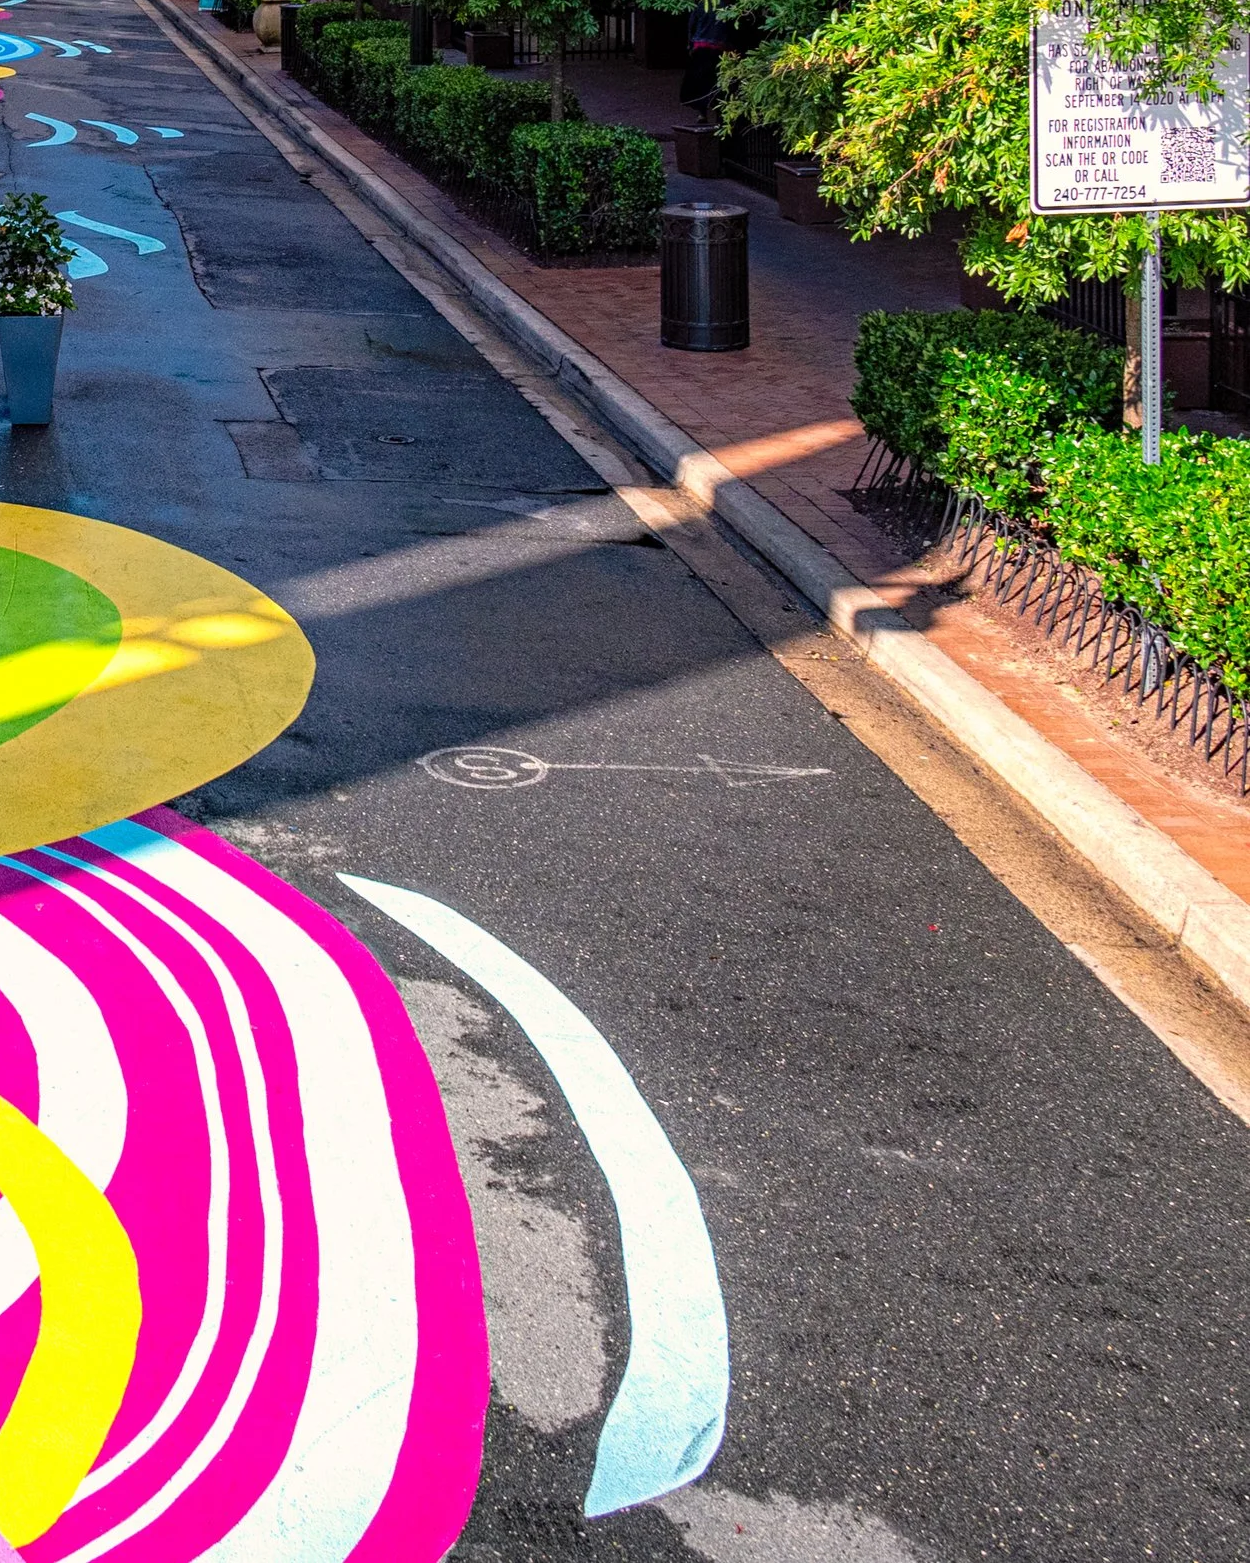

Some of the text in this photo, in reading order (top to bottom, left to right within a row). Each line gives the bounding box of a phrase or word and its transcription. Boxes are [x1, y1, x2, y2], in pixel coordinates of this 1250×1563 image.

[1048, 43, 1068, 58] HAS
[1069, 60, 1089, 74] FOR
[1095, 56, 1163, 72] ABANDONME
[1075, 76, 1104, 91] RIGHT
[1109, 76, 1123, 90] OF
[1127, 75, 1151, 90] WA
[1065, 93, 1125, 109] SEPTEMBER
[1146, 91, 1174, 106] 2020
[1048, 117, 1146, 133] FOR REGISTRATION
[1063, 134, 1131, 149] INFORMATION
[1045, 150, 1149, 167] SCAN THE QR CODE
[1075, 168, 1119, 183] OR CALL
[1054, 185, 1146, 202] 240-777-7254
